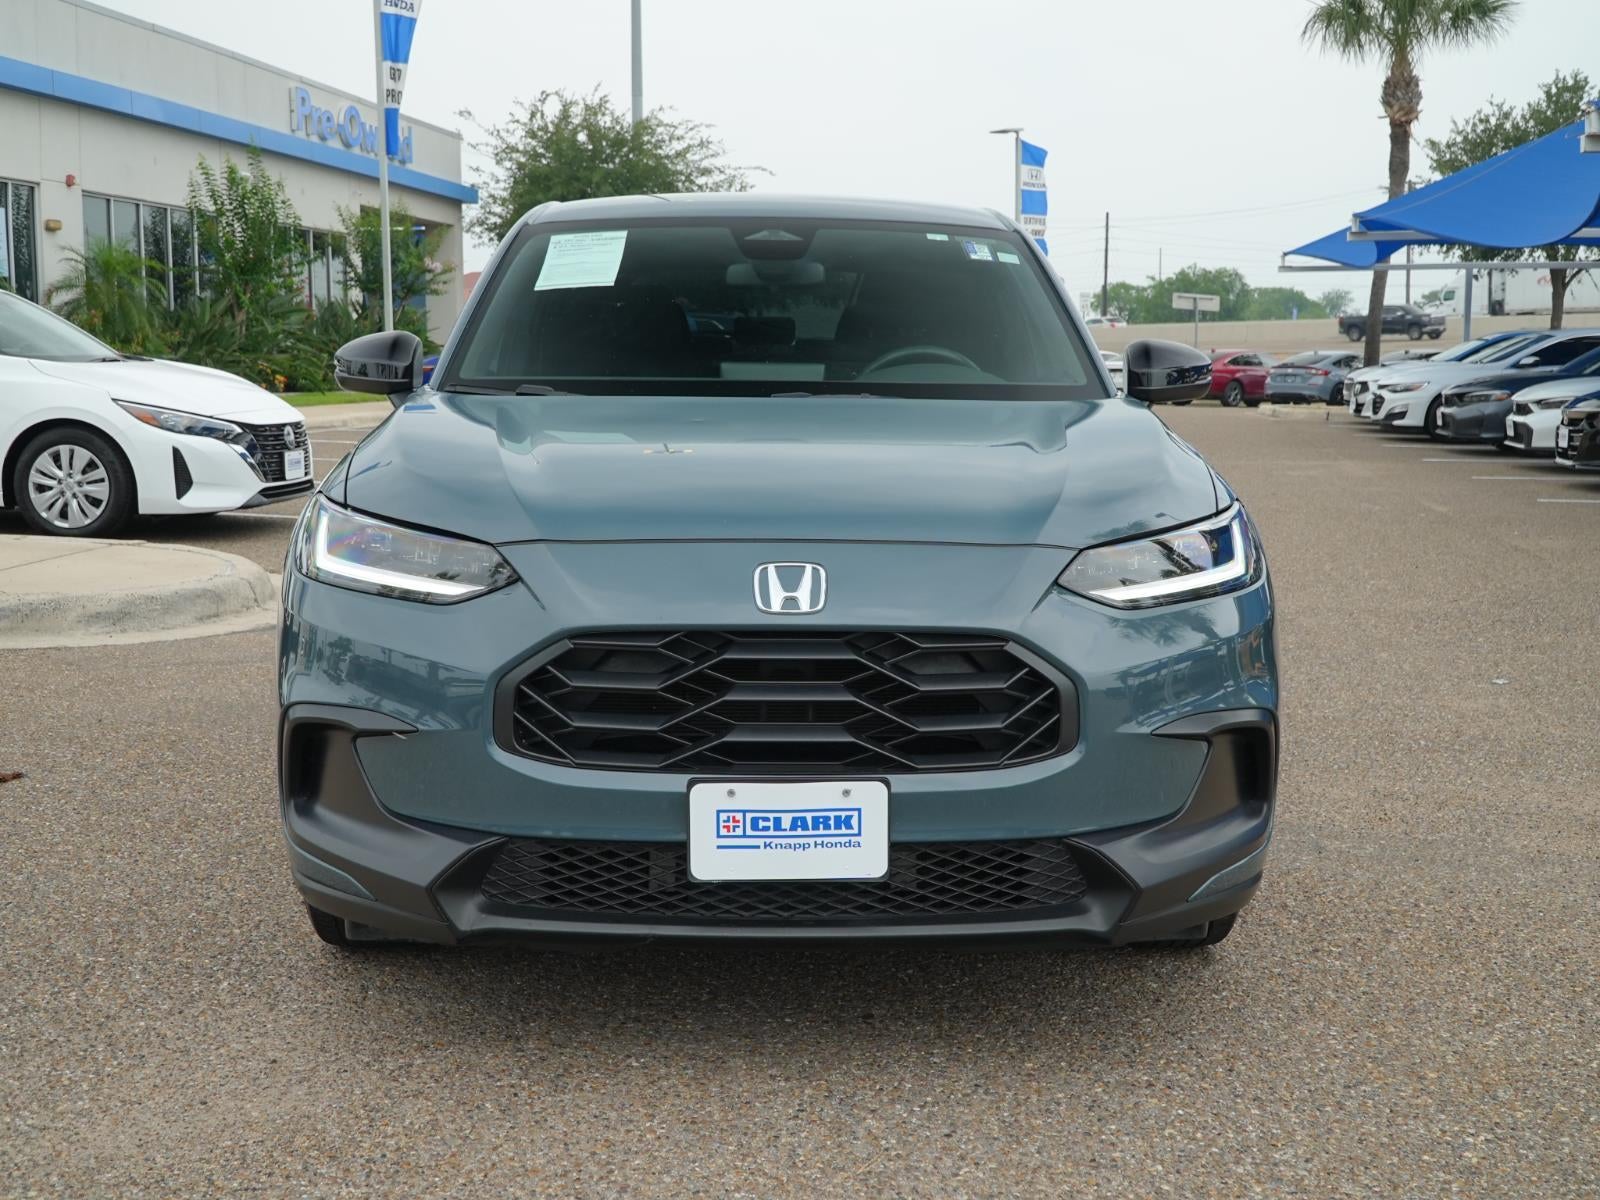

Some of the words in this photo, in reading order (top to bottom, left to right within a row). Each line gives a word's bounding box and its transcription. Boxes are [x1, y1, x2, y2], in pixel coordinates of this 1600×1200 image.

[749, 813, 855, 833] CLARK
[763, 840, 811, 852] Knapp
[813, 838, 862, 850] Honda
